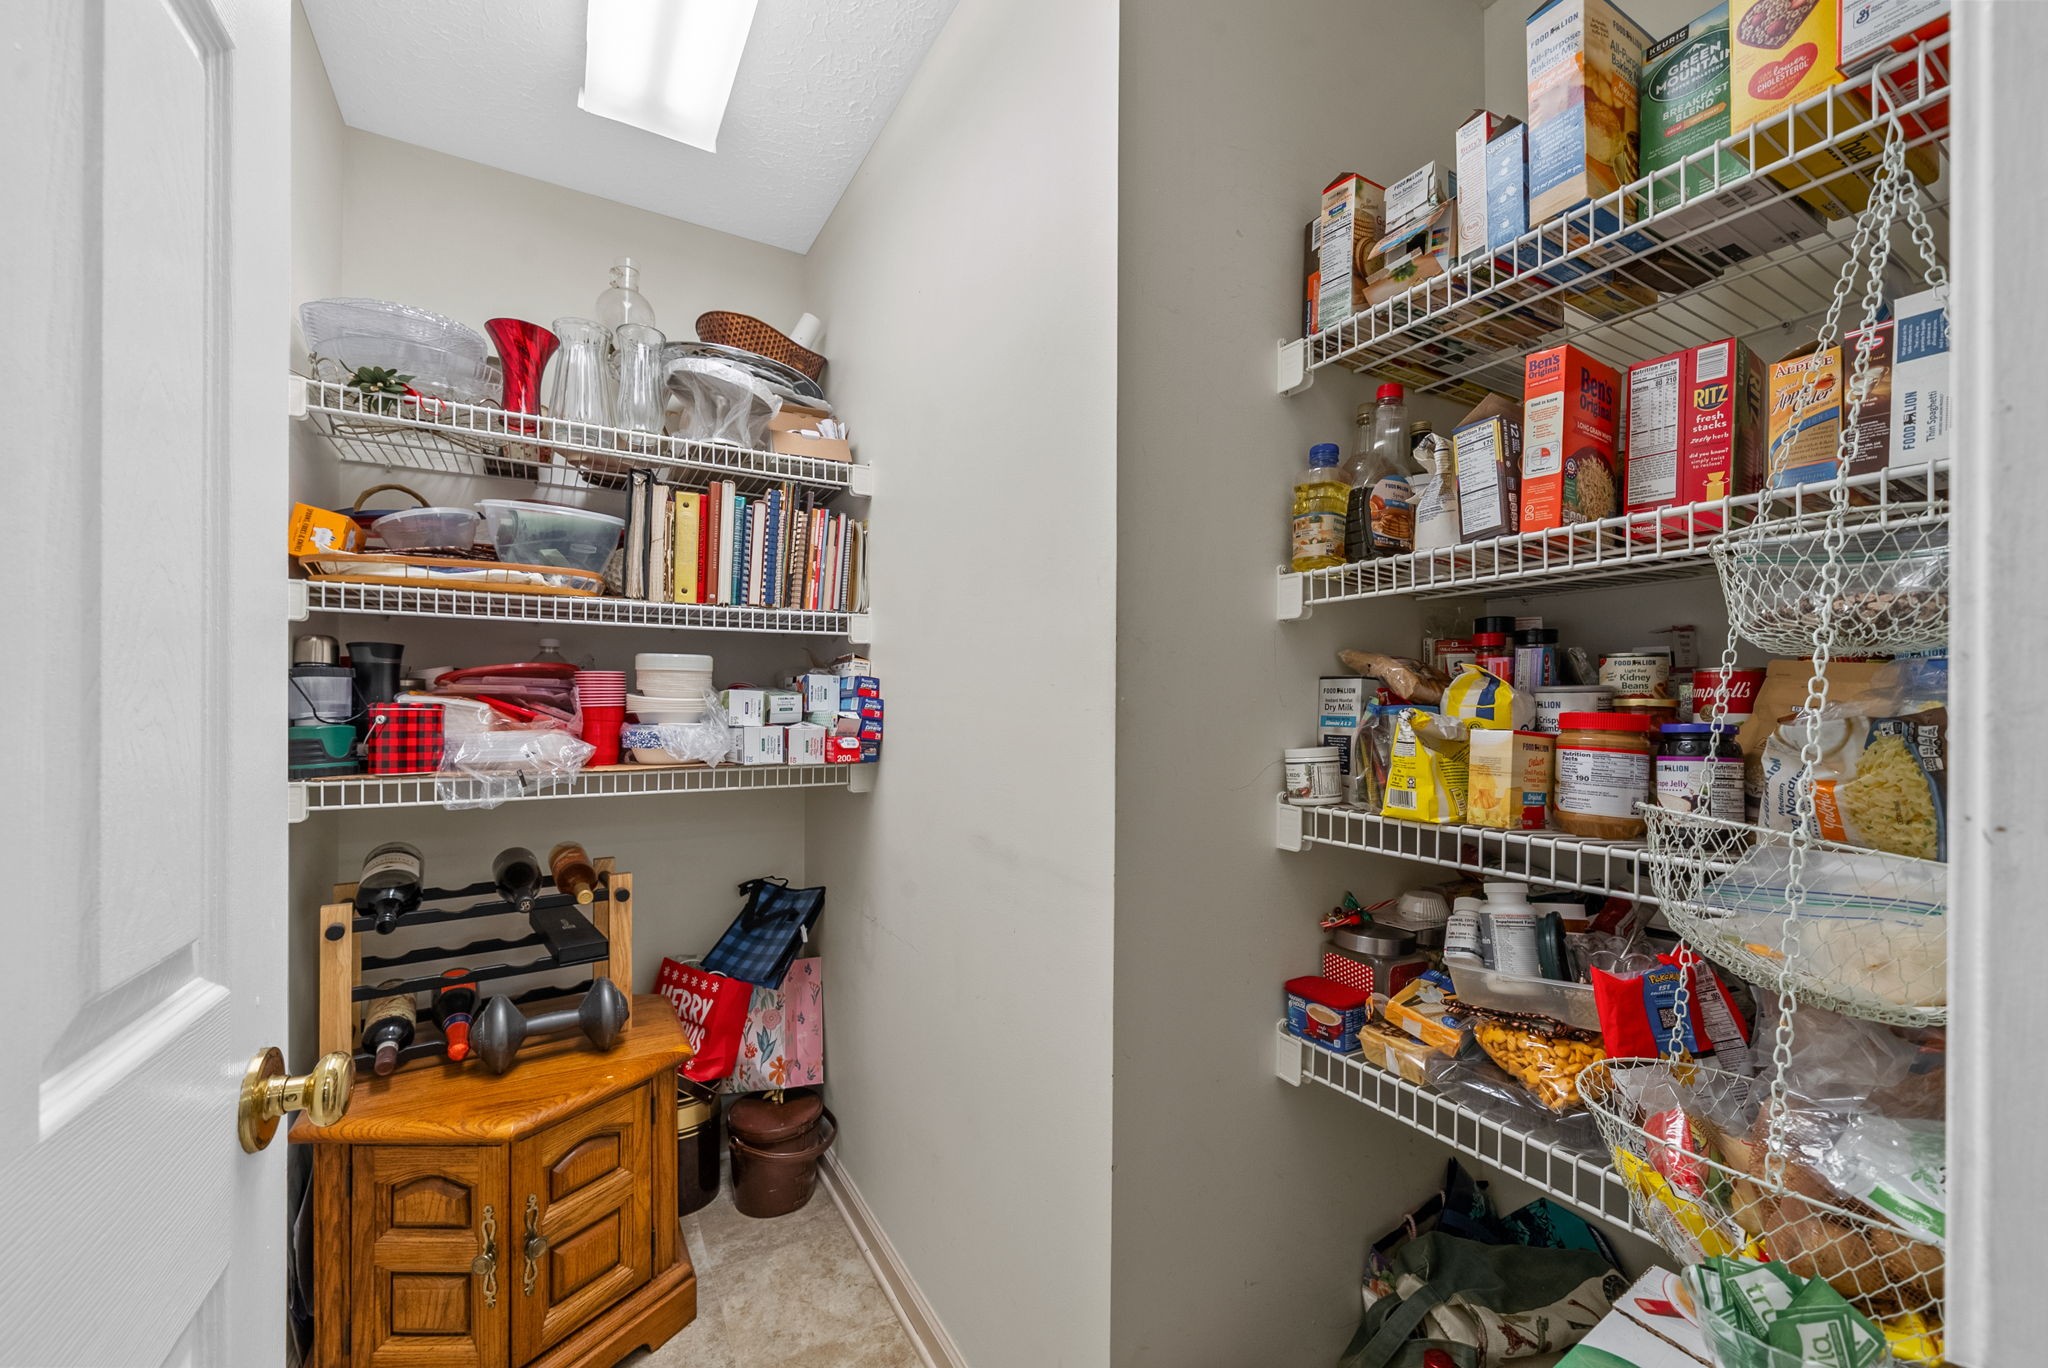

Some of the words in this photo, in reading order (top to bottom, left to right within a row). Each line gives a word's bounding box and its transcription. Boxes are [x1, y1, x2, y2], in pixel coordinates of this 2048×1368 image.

[1530, 31, 1549, 48] FOOD
[1560, 12, 1579, 28] LION
[1530, 30, 1581, 67] All-Purpose
[1649, 29, 1688, 55] KEURIG
[1531, 52, 1560, 76] Baking
[1561, 41, 1579, 55] Mix
[1668, 41, 1721, 76] GREEN
[1757, 60, 1809, 93] CHOLESTEROL
[1663, 81, 1728, 121] BREAKFAST
[1675, 99, 1714, 123] BLEND
[1528, 364, 1560, 379] Original
[1529, 354, 1560, 372] Ben's
[1632, 365, 1659, 376] Nutrition
[1659, 361, 1677, 369] Facts
[1775, 356, 1833, 378] ALPIE
[1581, 367, 1613, 405] Ben's
[1666, 376, 1677, 384] 210
[1693, 384, 1729, 408] RITZ
[1903, 391, 1917, 413] LION
[1580, 394, 1612, 422] Original
[1696, 411, 1724, 423] fresh
[1926, 391, 1938, 425] Spaghetti
[1457, 427, 1478, 439] Nutrition
[1478, 423, 1492, 433] Facts
[1510, 423, 1519, 438] 12
[1692, 420, 1727, 433] stacks
[1926, 425, 1937, 443] Thin
[1712, 432, 1729, 441] herb
[1902, 425, 1916, 451] FOOD
[1710, 447, 1729, 455] know?
[1619, 673, 1651, 683] Kidney
[1621, 682, 1649, 690] Beans
[1324, 703, 1337, 713] Dry
[1337, 703, 1354, 711] Milk
[1543, 701, 1561, 709] LION
[1538, 716, 1560, 726] Crispy
[837, 754, 852, 762] 200
[1671, 764, 1689, 772] LION
[1765, 757, 1782, 782] LION
[1670, 780, 1689, 789] Jelly
[1527, 793, 1543, 801] Original
[1777, 783, 1786, 817] Medium
[661, 983, 714, 1025] MERRY
